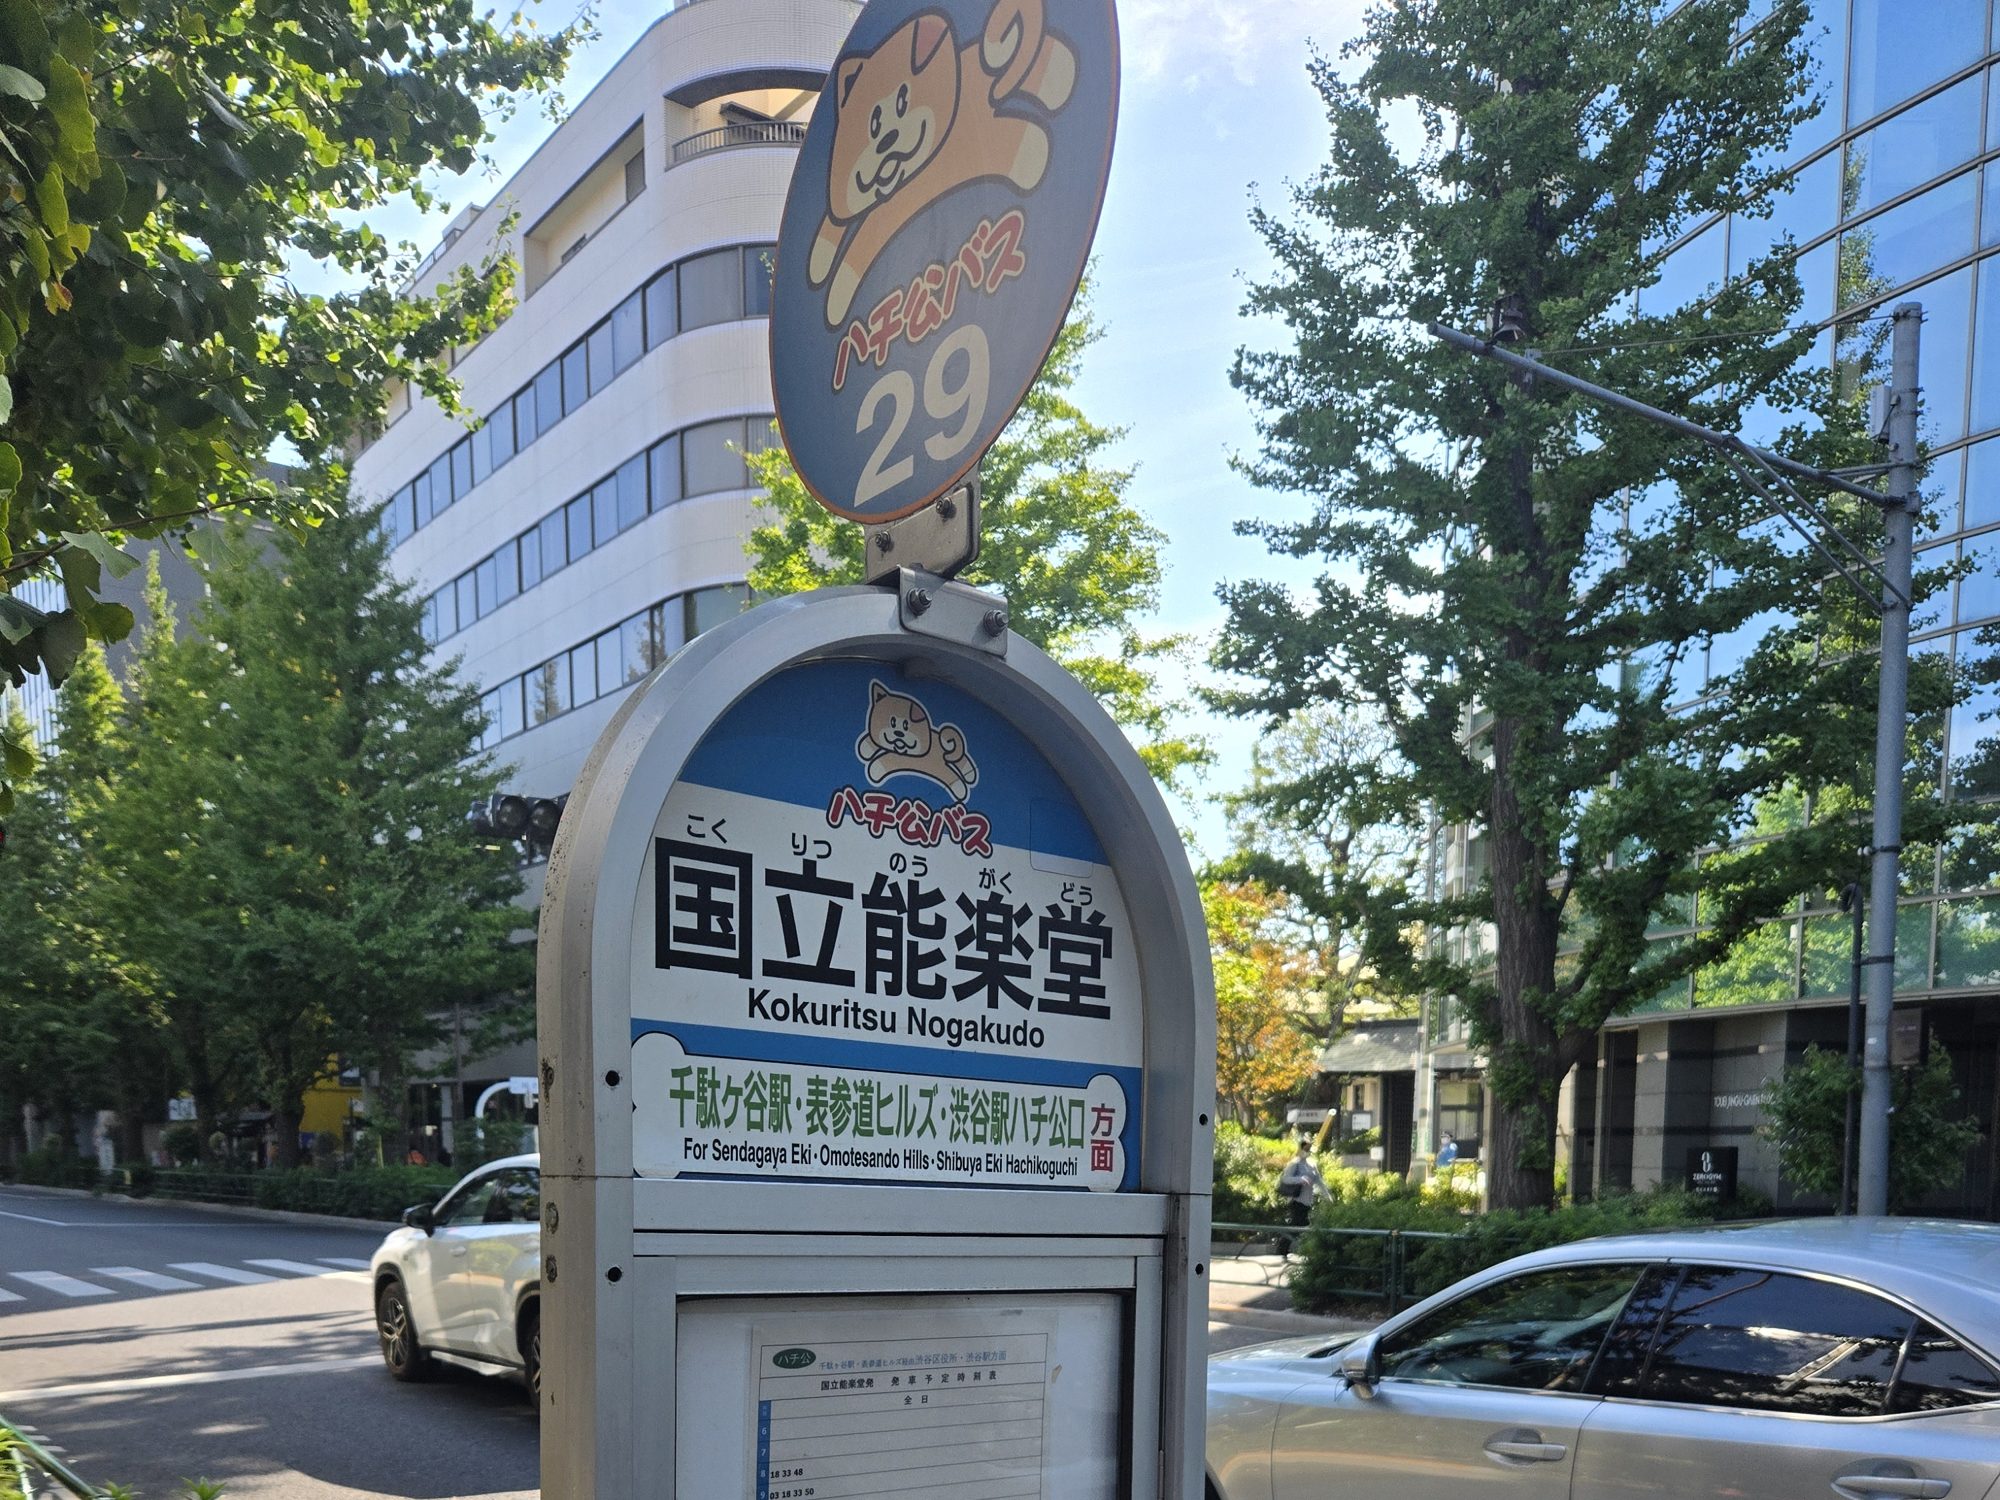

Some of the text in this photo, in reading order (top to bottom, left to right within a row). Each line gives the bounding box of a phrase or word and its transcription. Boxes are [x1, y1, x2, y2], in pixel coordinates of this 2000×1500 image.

[832, 209, 1026, 391] ハチ公バス
[854, 324, 990, 507] 29
[827, 785, 993, 858] ハチ公バス
[687, 813, 1093, 905] こく りつ のう がく どう
[655, 837, 1112, 1020] 国立能楽堂
[748, 988, 1045, 1047] Kokuritsu Nogakudo
[684, 1138, 709, 1160] For
[712, 1139, 787, 1169] Sendagaya
[985, 1153, 1002, 1173] Eki
[1006, 1154, 1078, 1180] Hachikoguchi
[1090, 1103, 1115, 1173] 方面
[778, 1352, 811, 1366] ハチ公
[761, 1427, 767, 1435] 6
[761, 1449, 767, 1457] 7
[770, 1491, 779, 1499] 03
[793, 1489, 802, 1497] 33
[805, 1487, 815, 1495] 50
[782, 1469, 791, 1477] 33
[794, 1468, 803, 1476] 48
